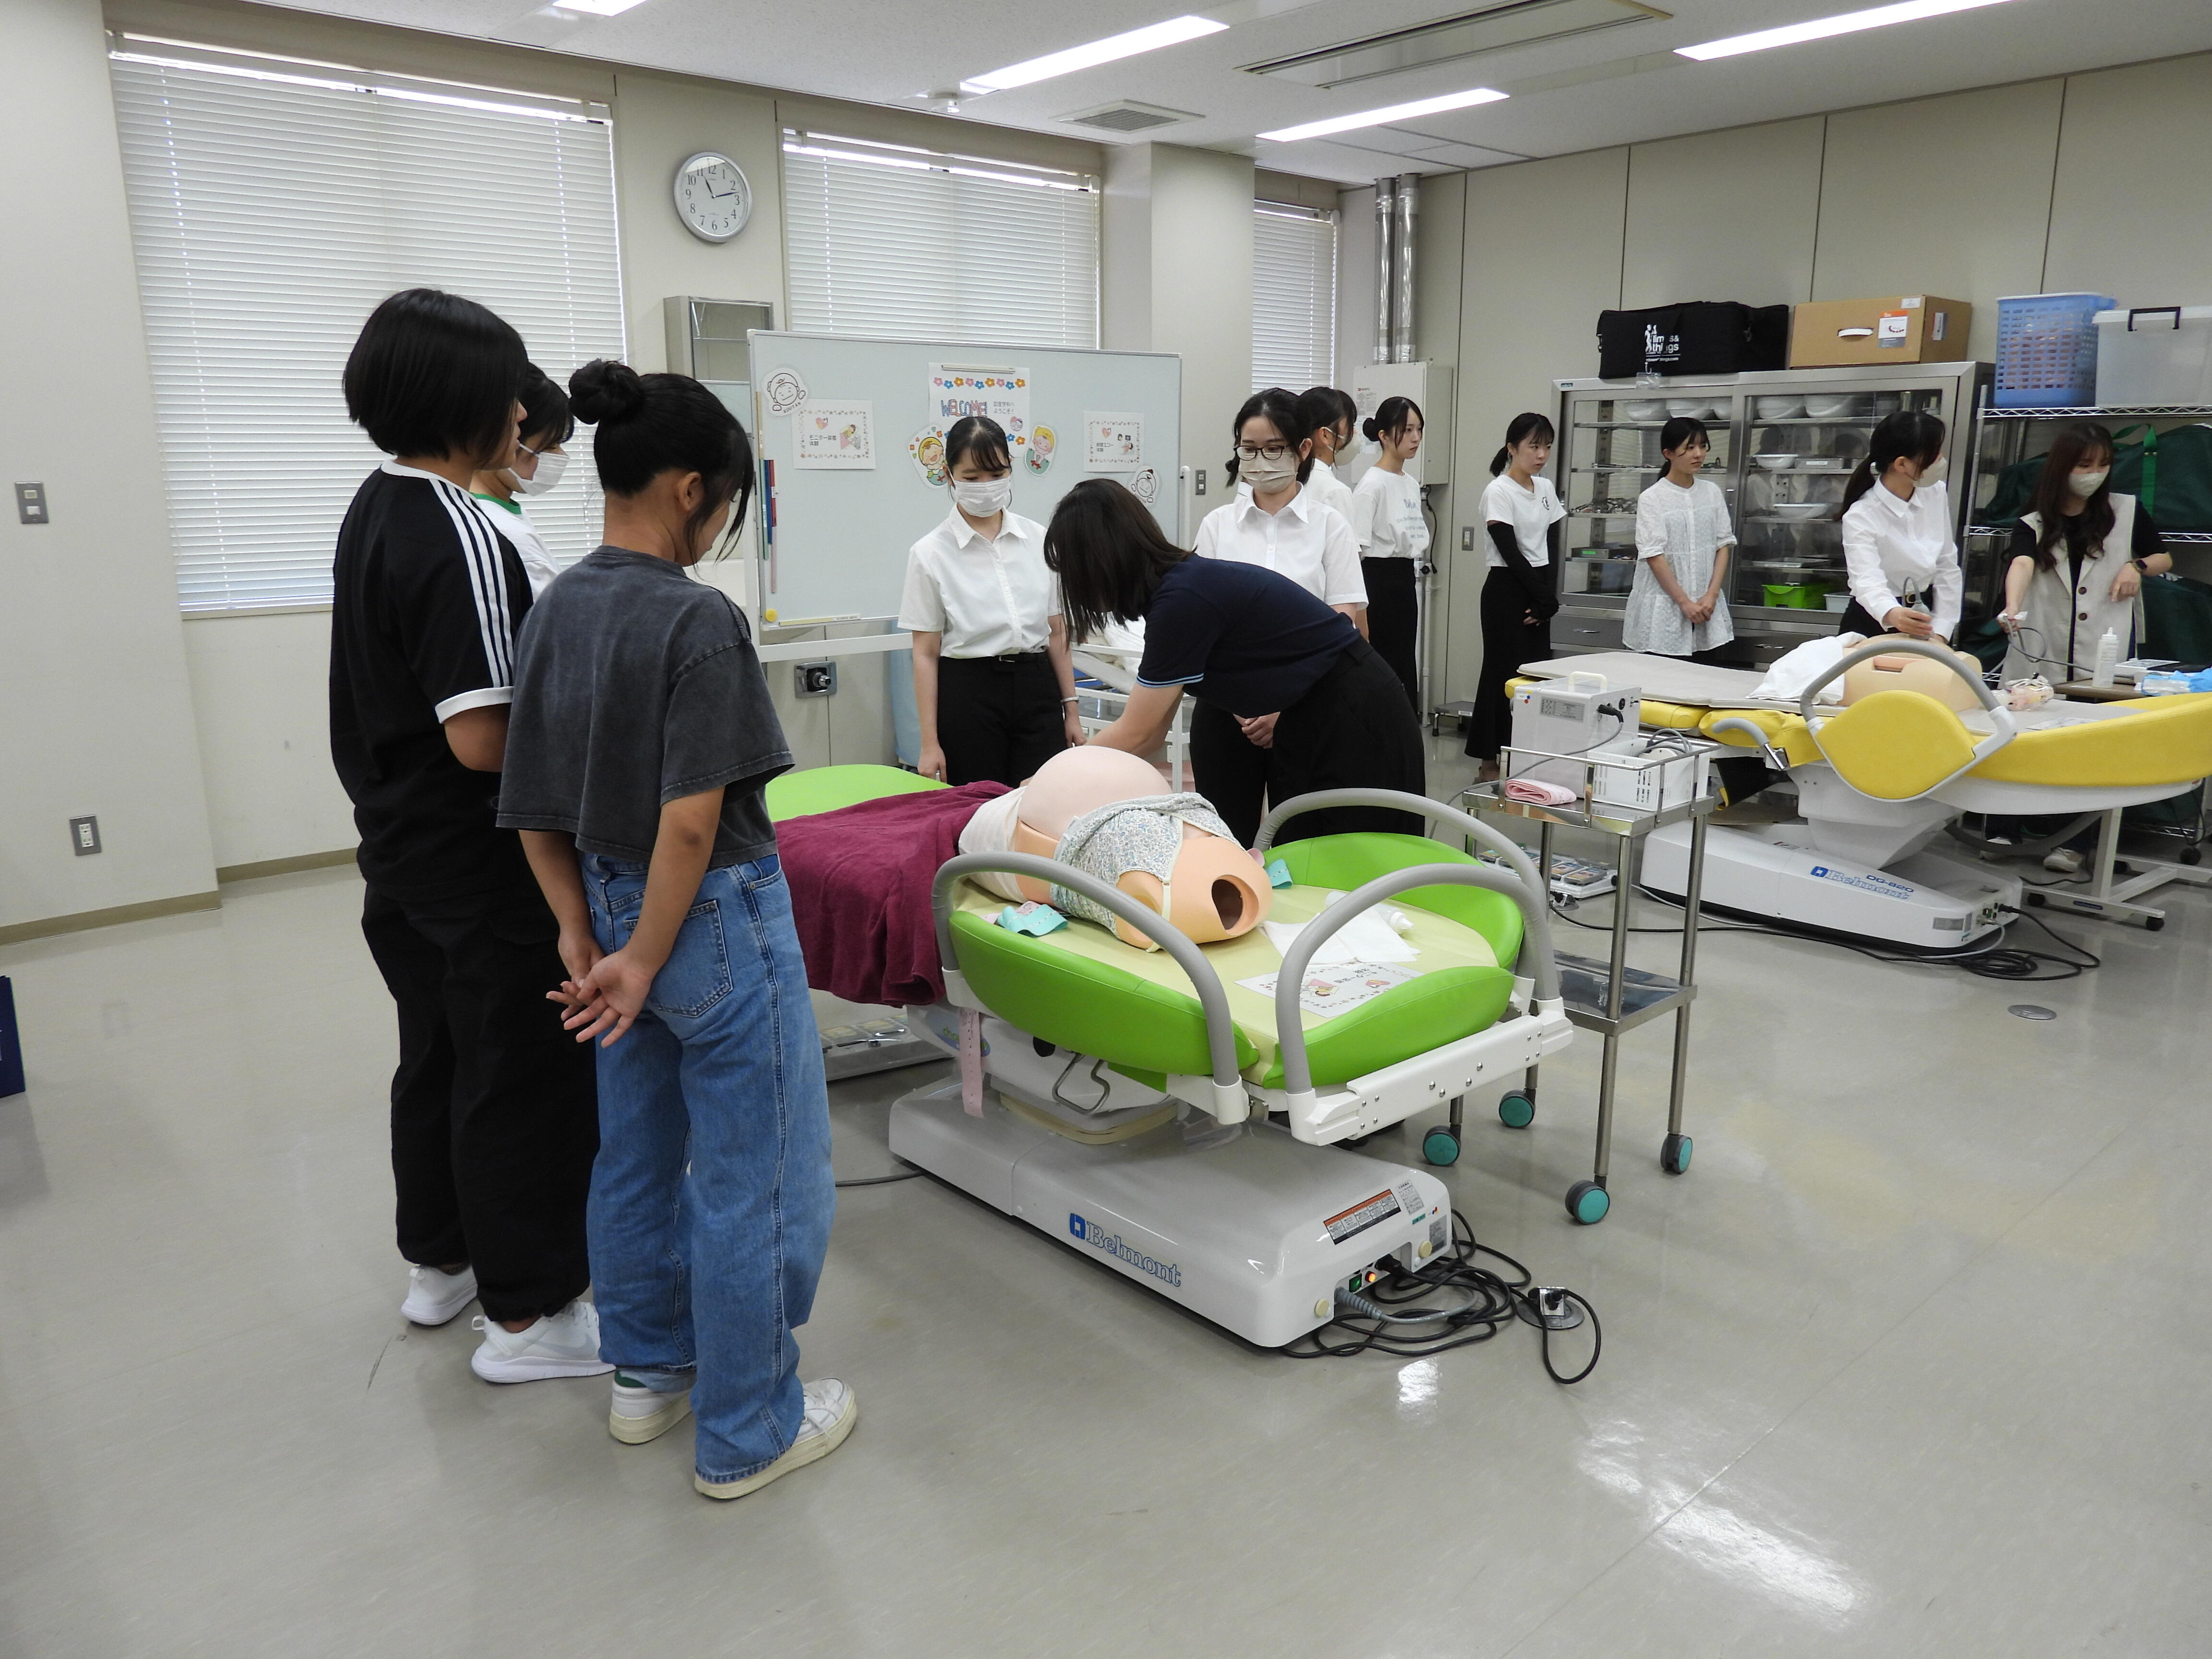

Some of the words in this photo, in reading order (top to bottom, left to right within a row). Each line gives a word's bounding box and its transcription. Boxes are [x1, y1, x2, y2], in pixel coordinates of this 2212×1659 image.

[697, 166, 703, 176] 11
[708, 165, 716, 174] 12
[722, 169, 725, 179] 1
[688, 175, 696, 185] 10
[730, 180, 736, 190] 2
[685, 189, 691, 199] 9
[734, 195, 740, 205] 3
[690, 204, 696, 213] 8
[731, 209, 736, 219] 4
[700, 216, 705, 225] 7
[712, 220, 717, 230] 6
[724, 218, 729, 228] 5
[1825, 870, 1910, 899] Belmont
[1086, 1221, 1181, 1287] Belmont
